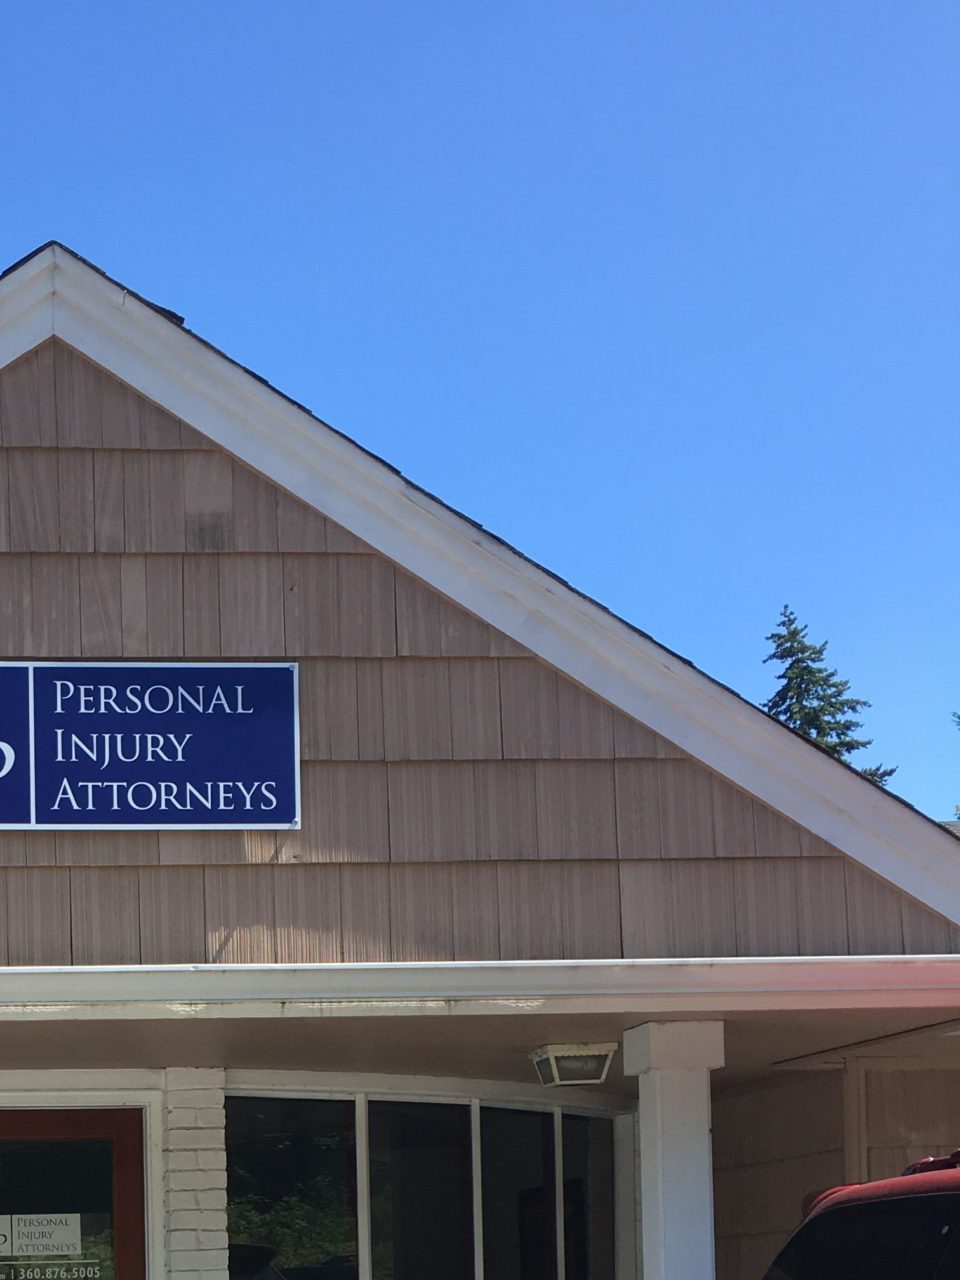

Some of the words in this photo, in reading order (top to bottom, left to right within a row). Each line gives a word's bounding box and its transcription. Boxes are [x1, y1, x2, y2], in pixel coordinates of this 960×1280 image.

[52, 679, 254, 716] PERSONAL
[54, 728, 193, 770] INJURY
[50, 777, 278, 812] ATTORNEYS
[16, 1217, 70, 1228] PERSONAL
[16, 1230, 55, 1241] INJURY
[16, 1242, 78, 1253] ATTORNEYS
[19, 1266, 101, 1280] 360.876.5005
